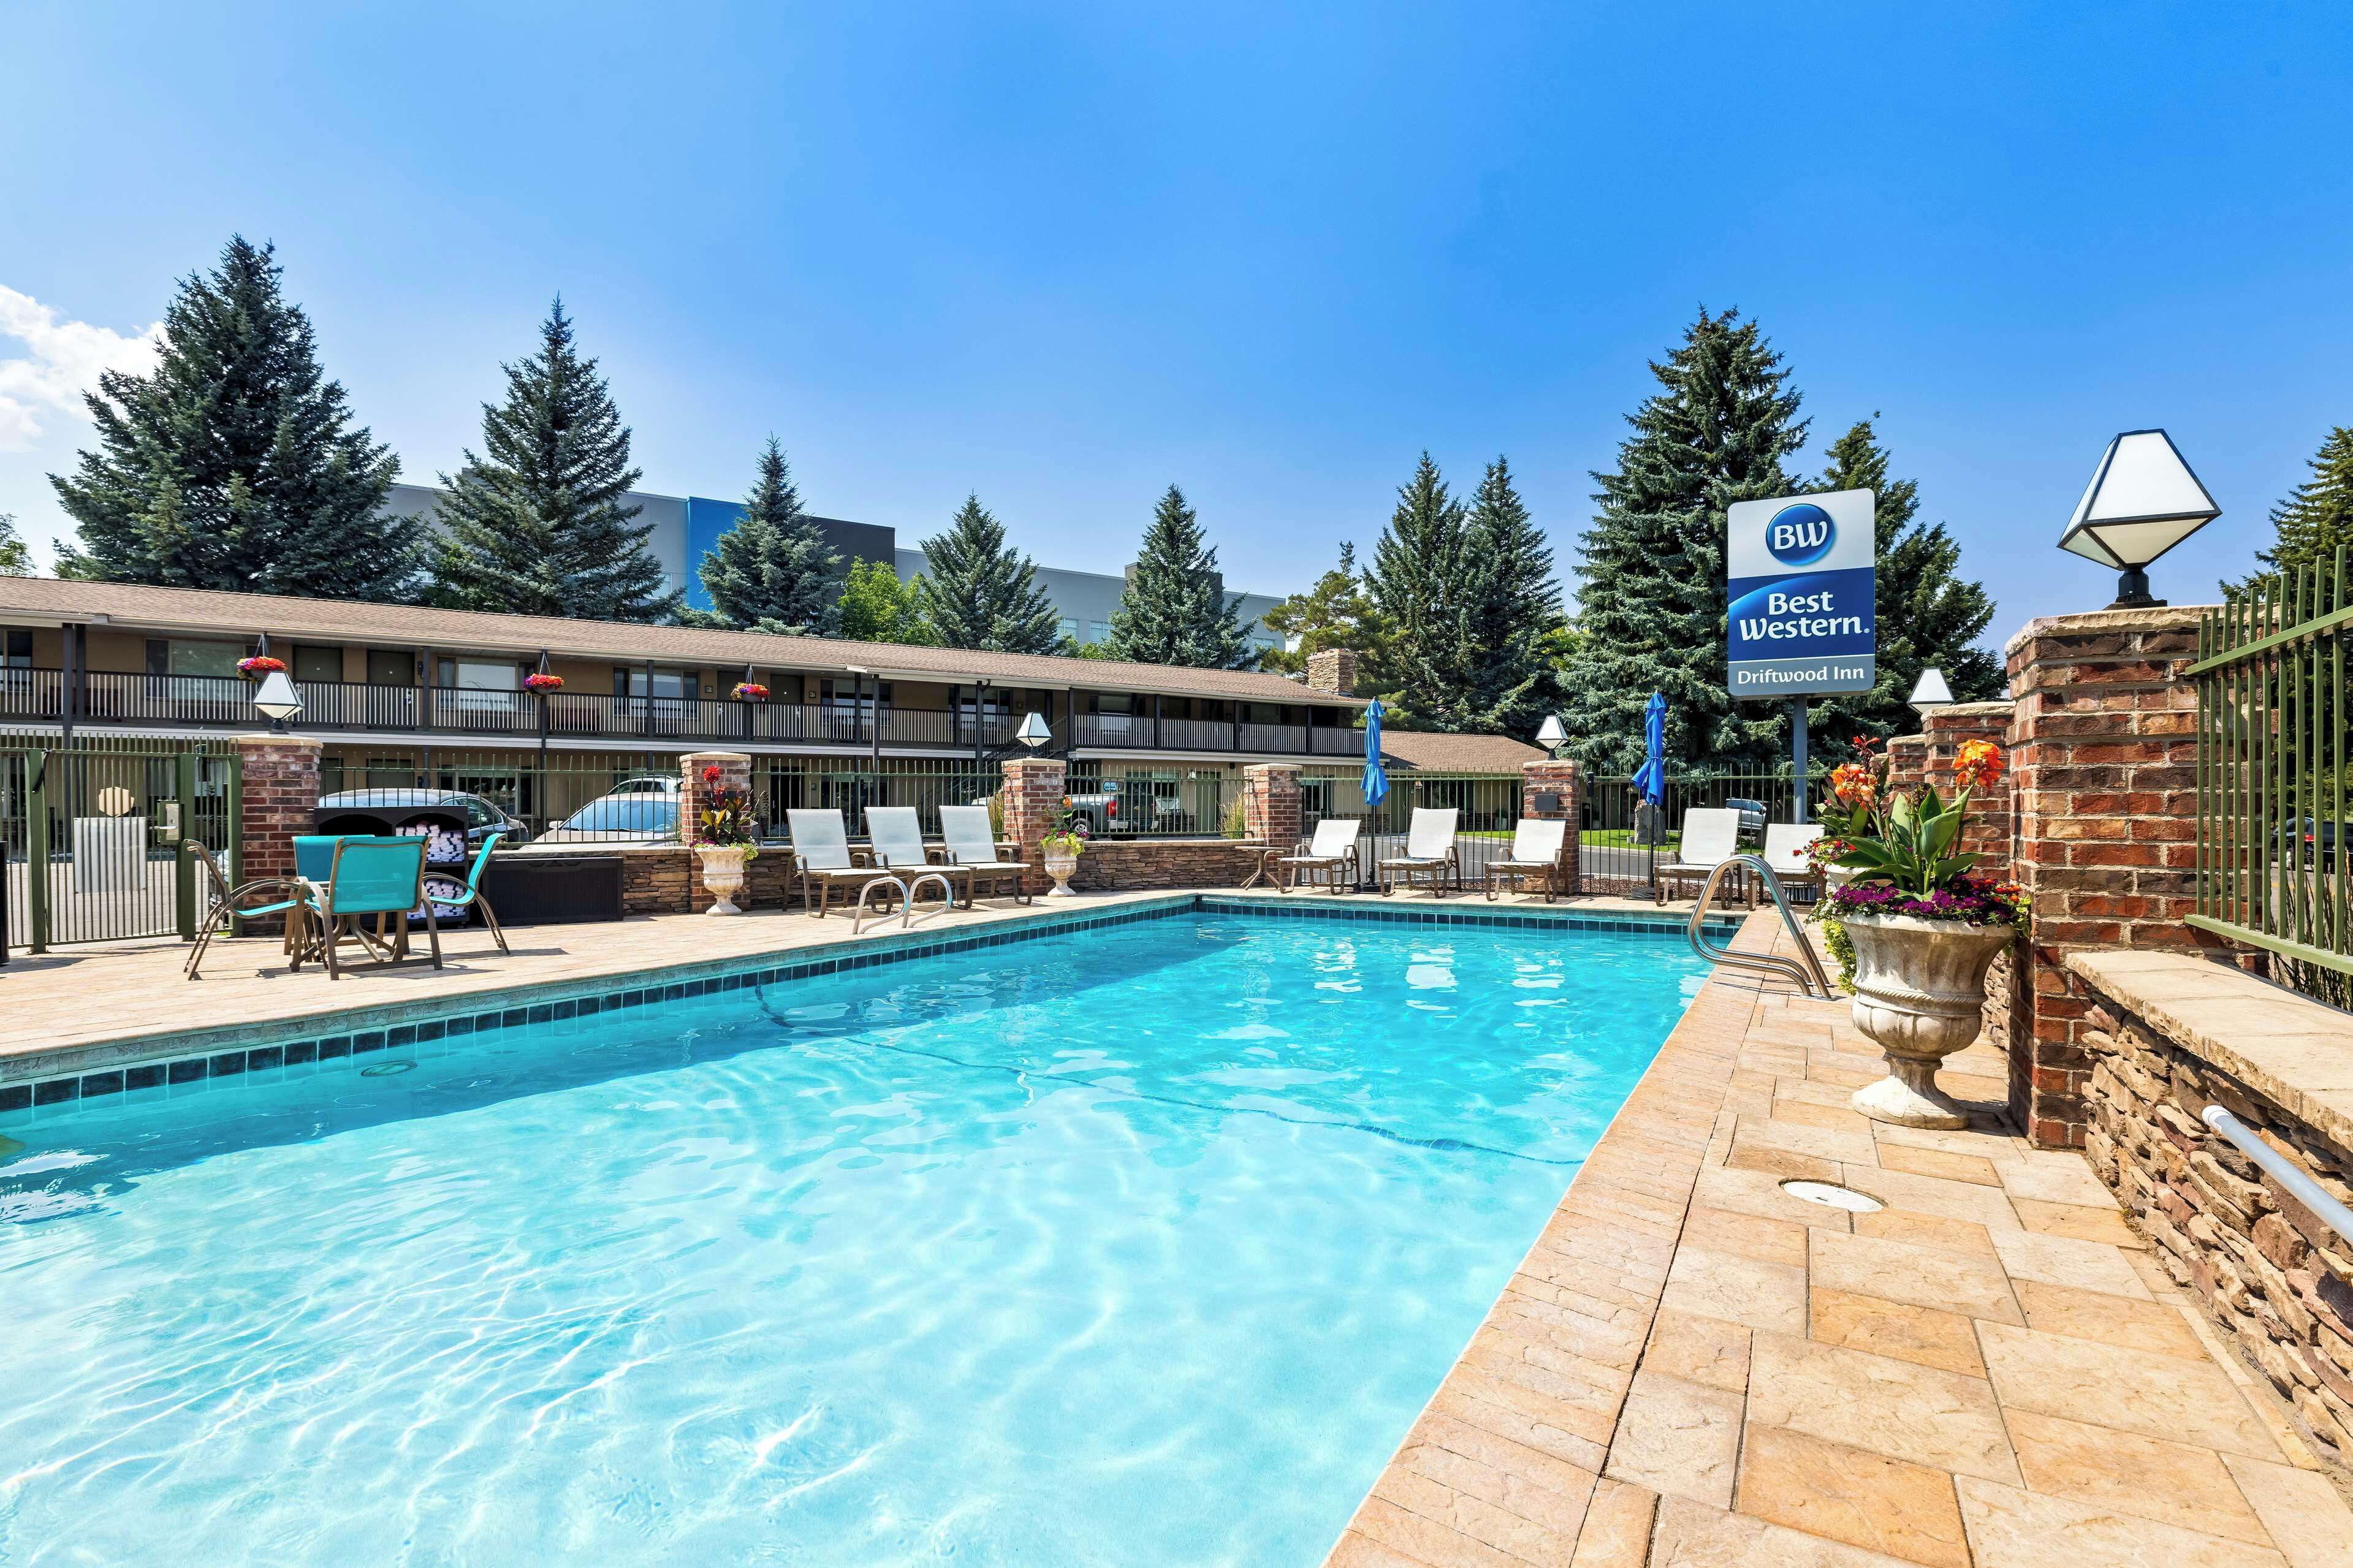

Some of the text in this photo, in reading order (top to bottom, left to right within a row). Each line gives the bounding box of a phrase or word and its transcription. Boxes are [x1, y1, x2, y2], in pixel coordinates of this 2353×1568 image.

[1774, 521, 1828, 550] BW
[1769, 591, 1834, 615] Best
[1738, 667, 1865, 684] Driftwood Inn
